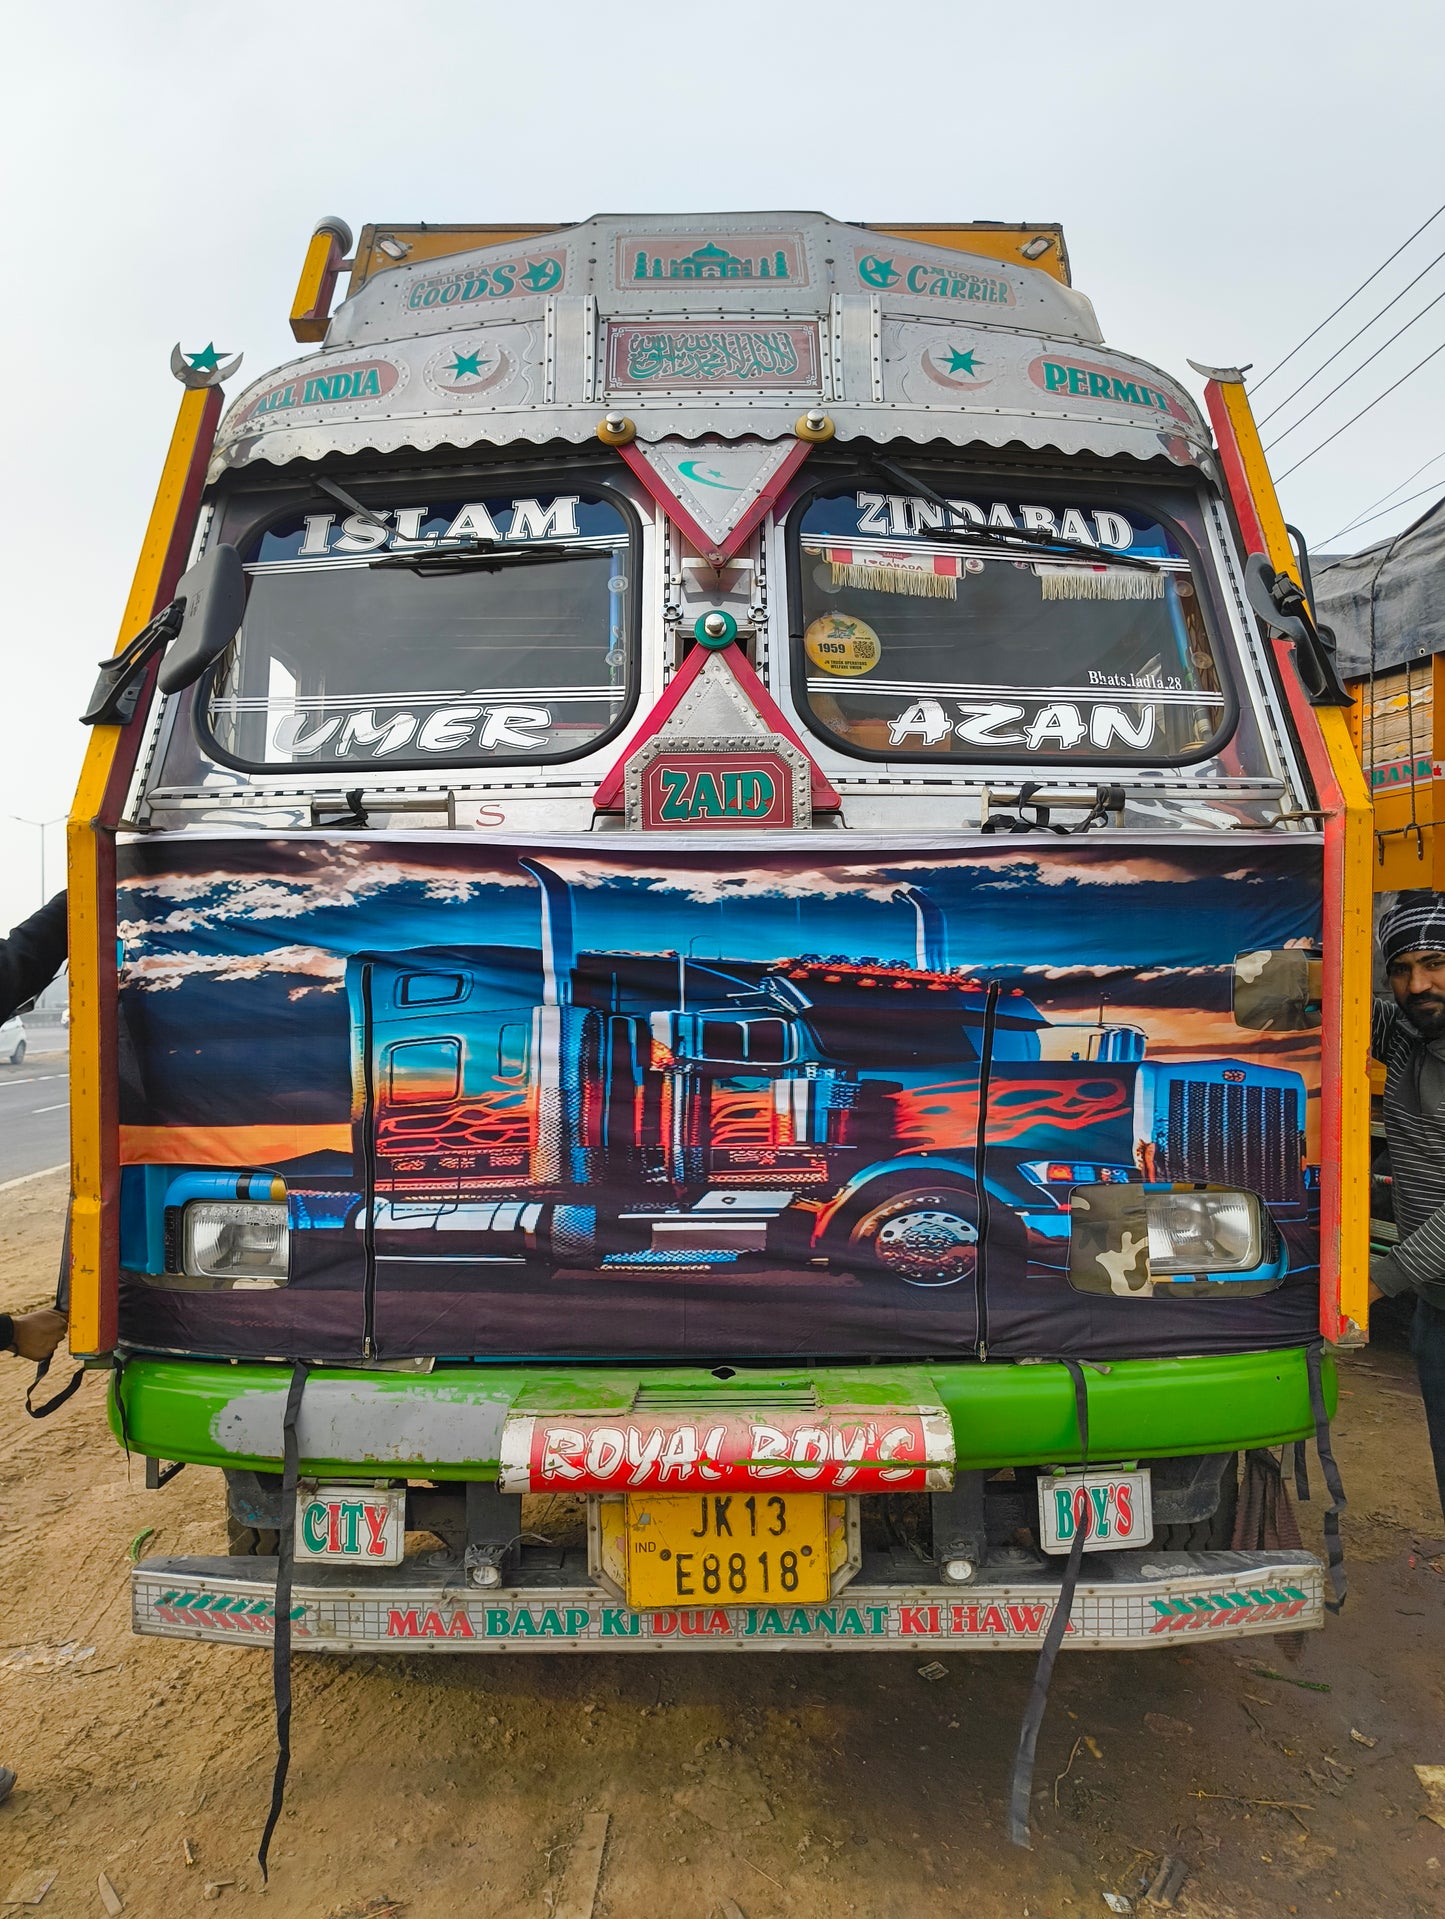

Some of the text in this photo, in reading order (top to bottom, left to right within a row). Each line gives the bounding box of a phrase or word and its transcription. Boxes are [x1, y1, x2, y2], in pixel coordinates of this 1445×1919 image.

[409, 264, 517, 309] GOODS
[248, 368, 381, 419] ALL INDIA
[1042, 361, 1171, 413] PERMIT
[297, 495, 580, 556] ISLAM
[856, 491, 1134, 551] ZINDABAD
[879, 561, 923, 571] CANADA
[817, 643, 846, 654] 1959
[273, 705, 552, 758] UMER
[887, 698, 1156, 751] AZAN
[476, 803, 506, 828] S
[660, 768, 776, 822] ZAID
[540, 1422, 915, 1488] ROYAL BOY'S
[302, 1500, 389, 1556] CITY
[1054, 1483, 1133, 1540] BOY'S
[635, 1541, 657, 1553] IND
[676, 1550, 799, 1595] E8818
[387, 1609, 475, 1637] MAA
[485, 1608, 590, 1637] BAAP
[600, 1608, 642, 1637] KI
[652, 1609, 734, 1636] DUA
[744, 1606, 889, 1635] JAANAT
[899, 1605, 943, 1634] KI
